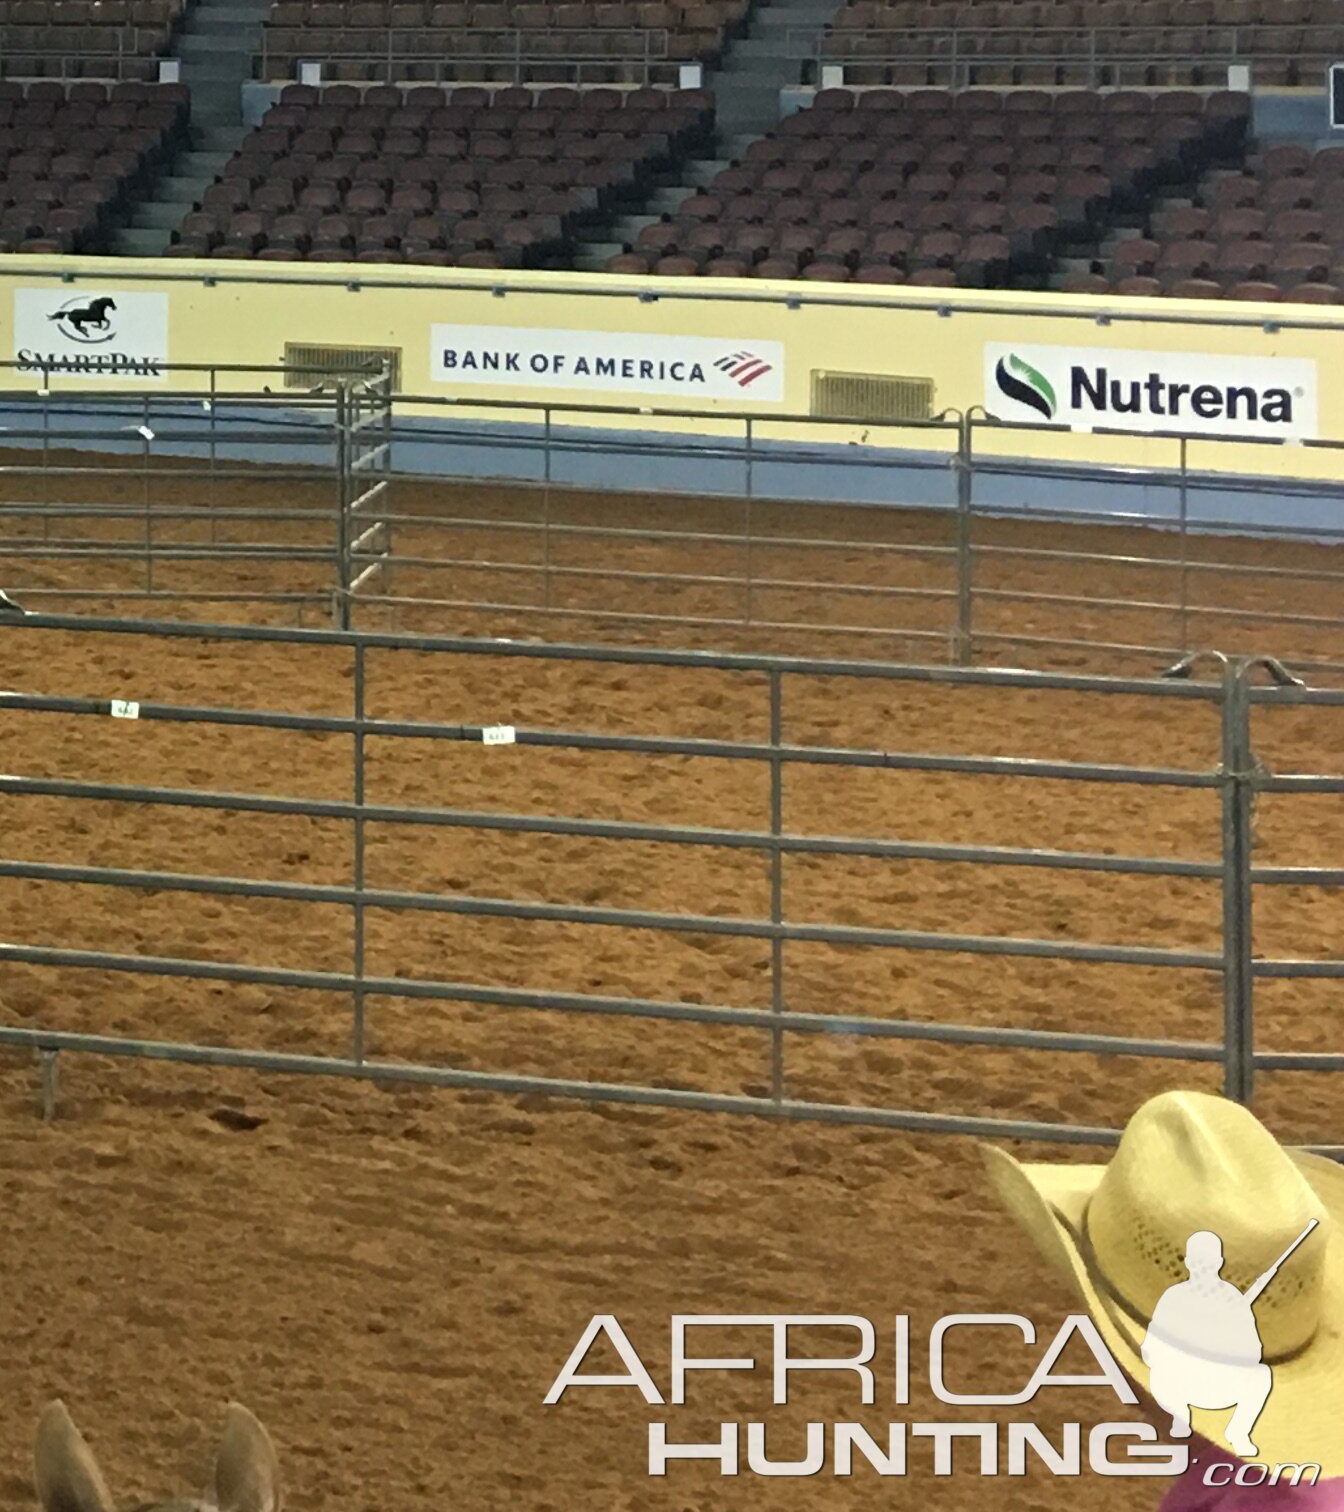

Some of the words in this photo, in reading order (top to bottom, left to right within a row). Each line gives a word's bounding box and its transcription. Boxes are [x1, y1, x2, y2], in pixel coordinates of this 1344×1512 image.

[443, 349, 520, 372] BANK
[530, 354, 565, 374] OF
[574, 357, 706, 383] AMERICA
[1070, 366, 1293, 423] Nutrena
